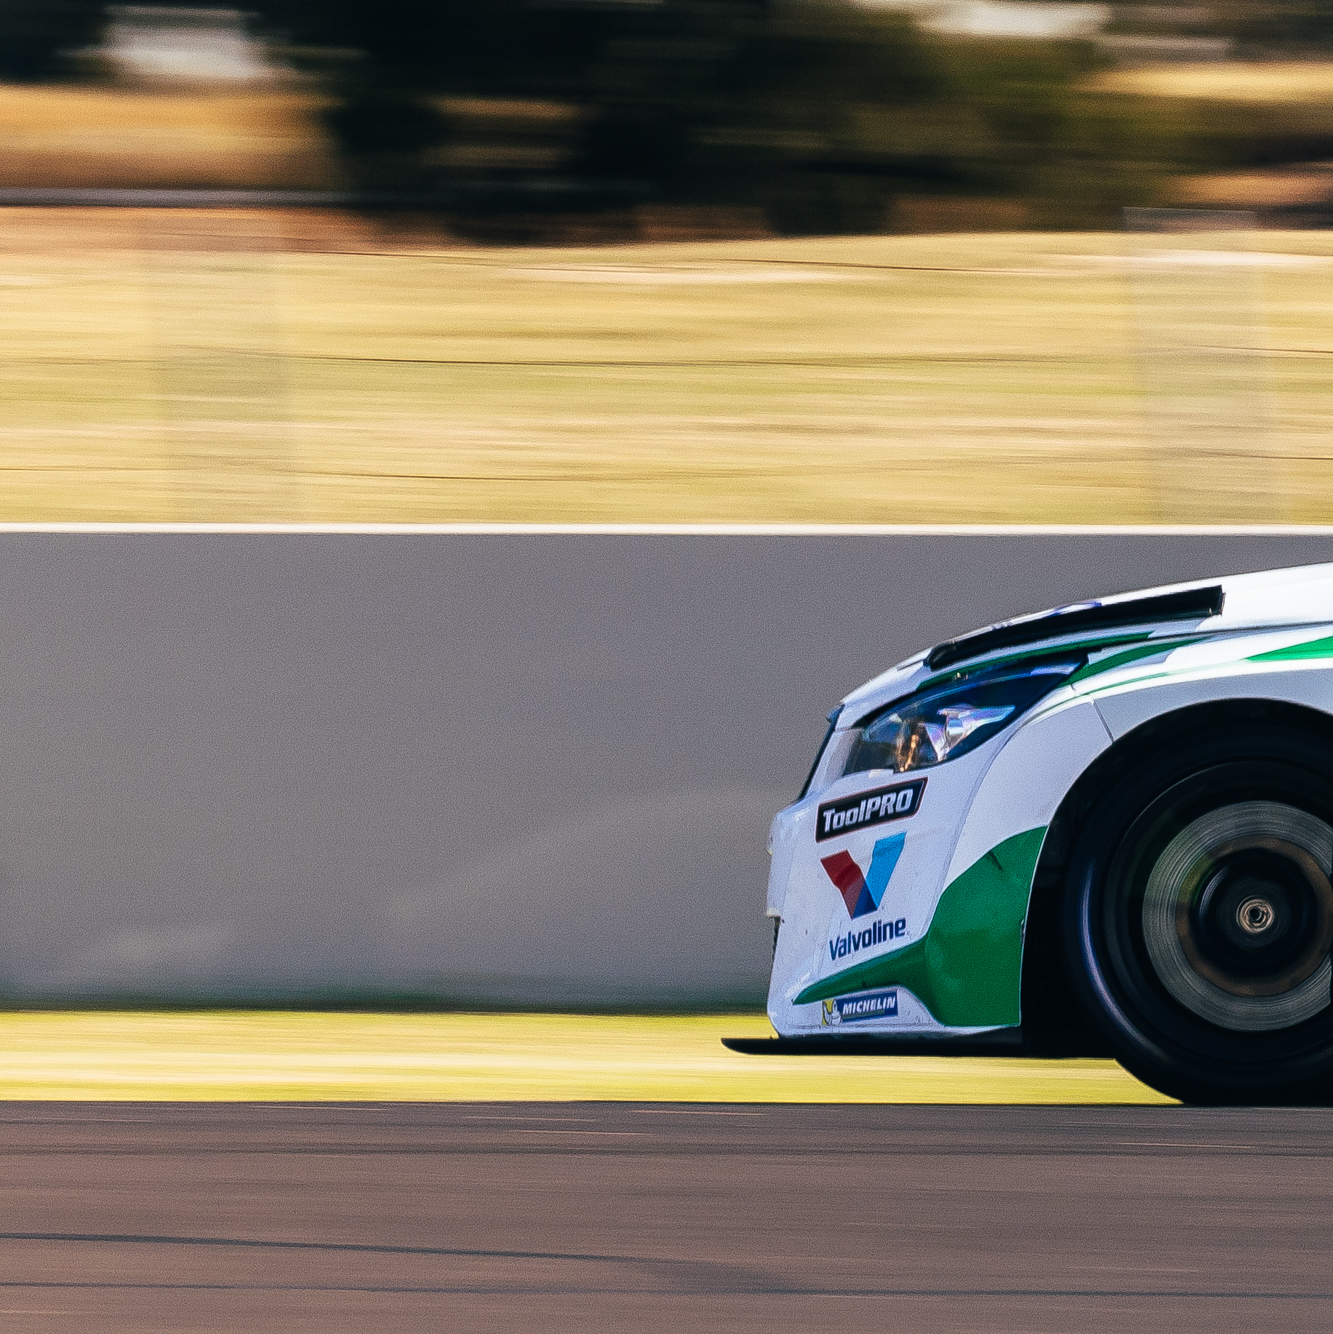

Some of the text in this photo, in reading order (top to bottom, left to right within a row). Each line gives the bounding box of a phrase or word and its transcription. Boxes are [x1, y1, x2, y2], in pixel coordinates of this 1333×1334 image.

[823, 788, 914, 833] ToolPRO
[829, 917, 907, 962] Valvoline
[842, 996, 897, 1016] MICHELIN
